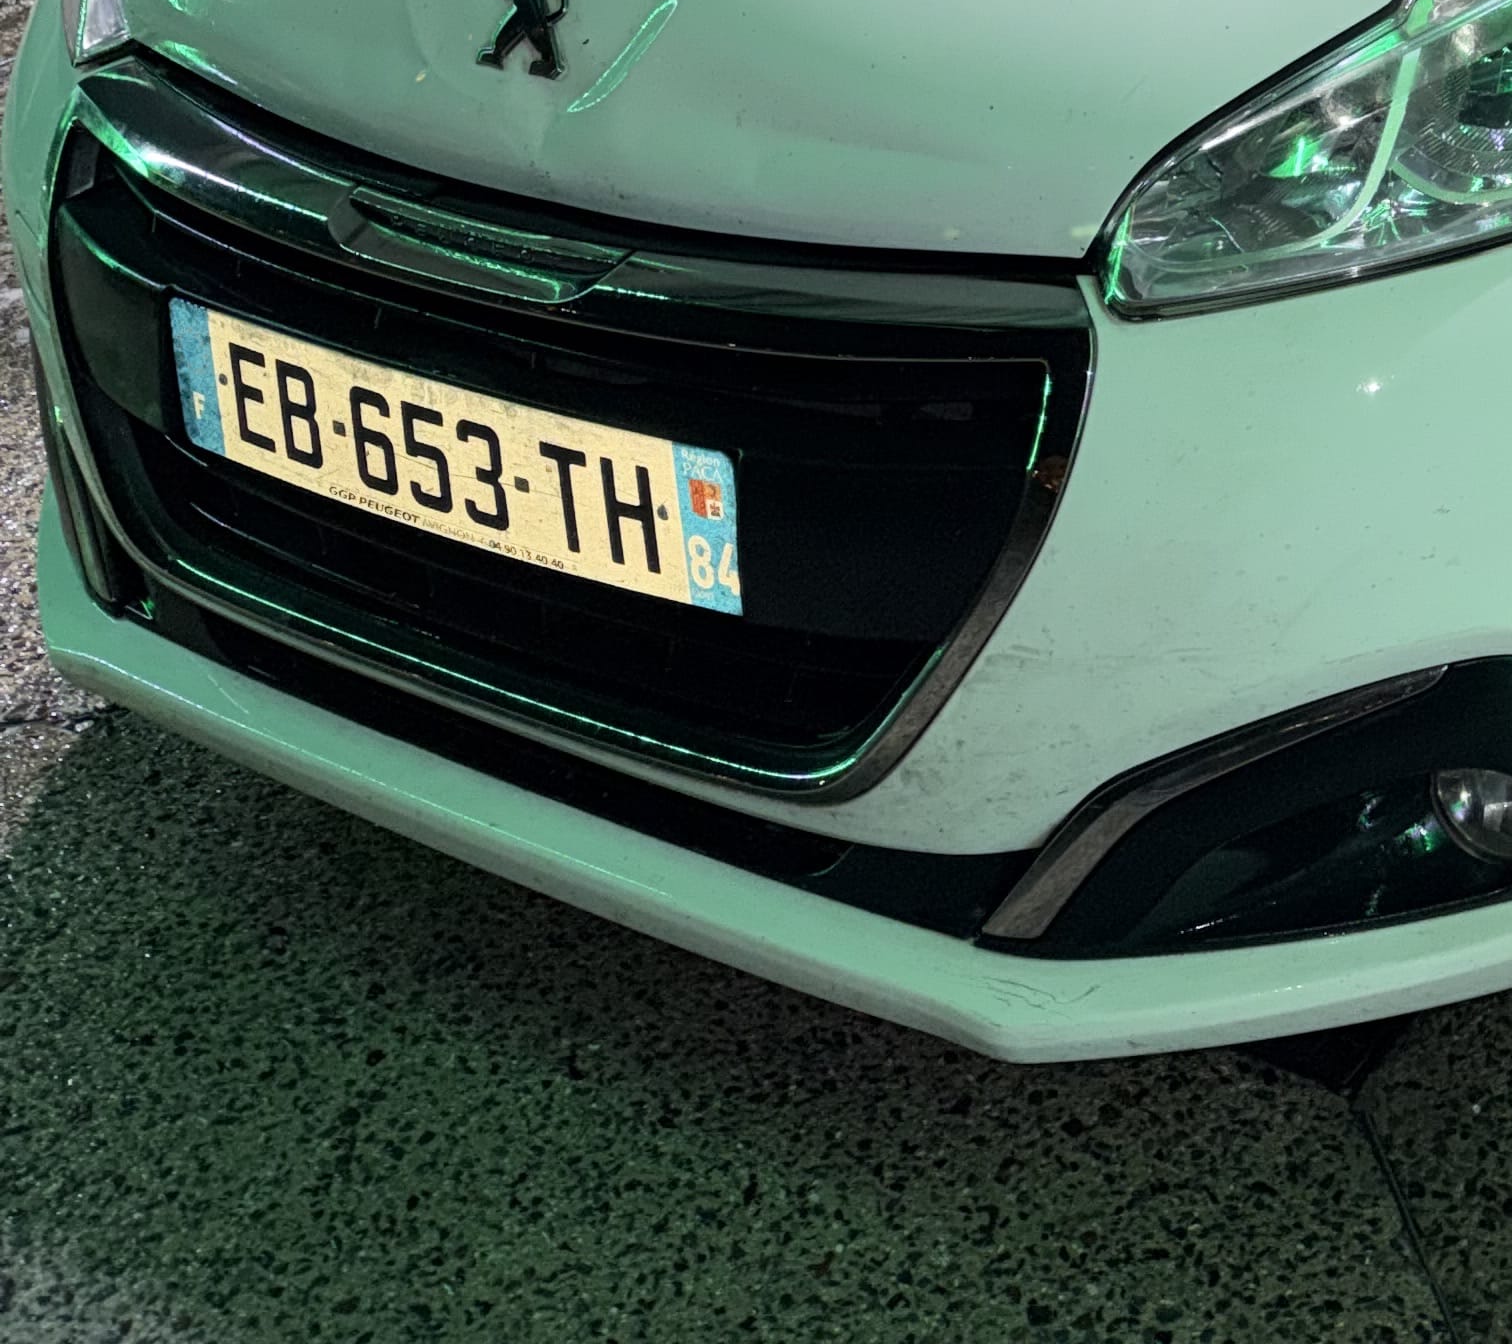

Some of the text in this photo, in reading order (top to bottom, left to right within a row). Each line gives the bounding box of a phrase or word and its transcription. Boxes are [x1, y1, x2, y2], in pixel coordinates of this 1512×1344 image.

[192, 391, 205, 419] F
[682, 462, 723, 483] PACA
[328, 486, 357, 501] GGP
[358, 496, 420, 524] PEUGEOT
[688, 534, 740, 596] 84
